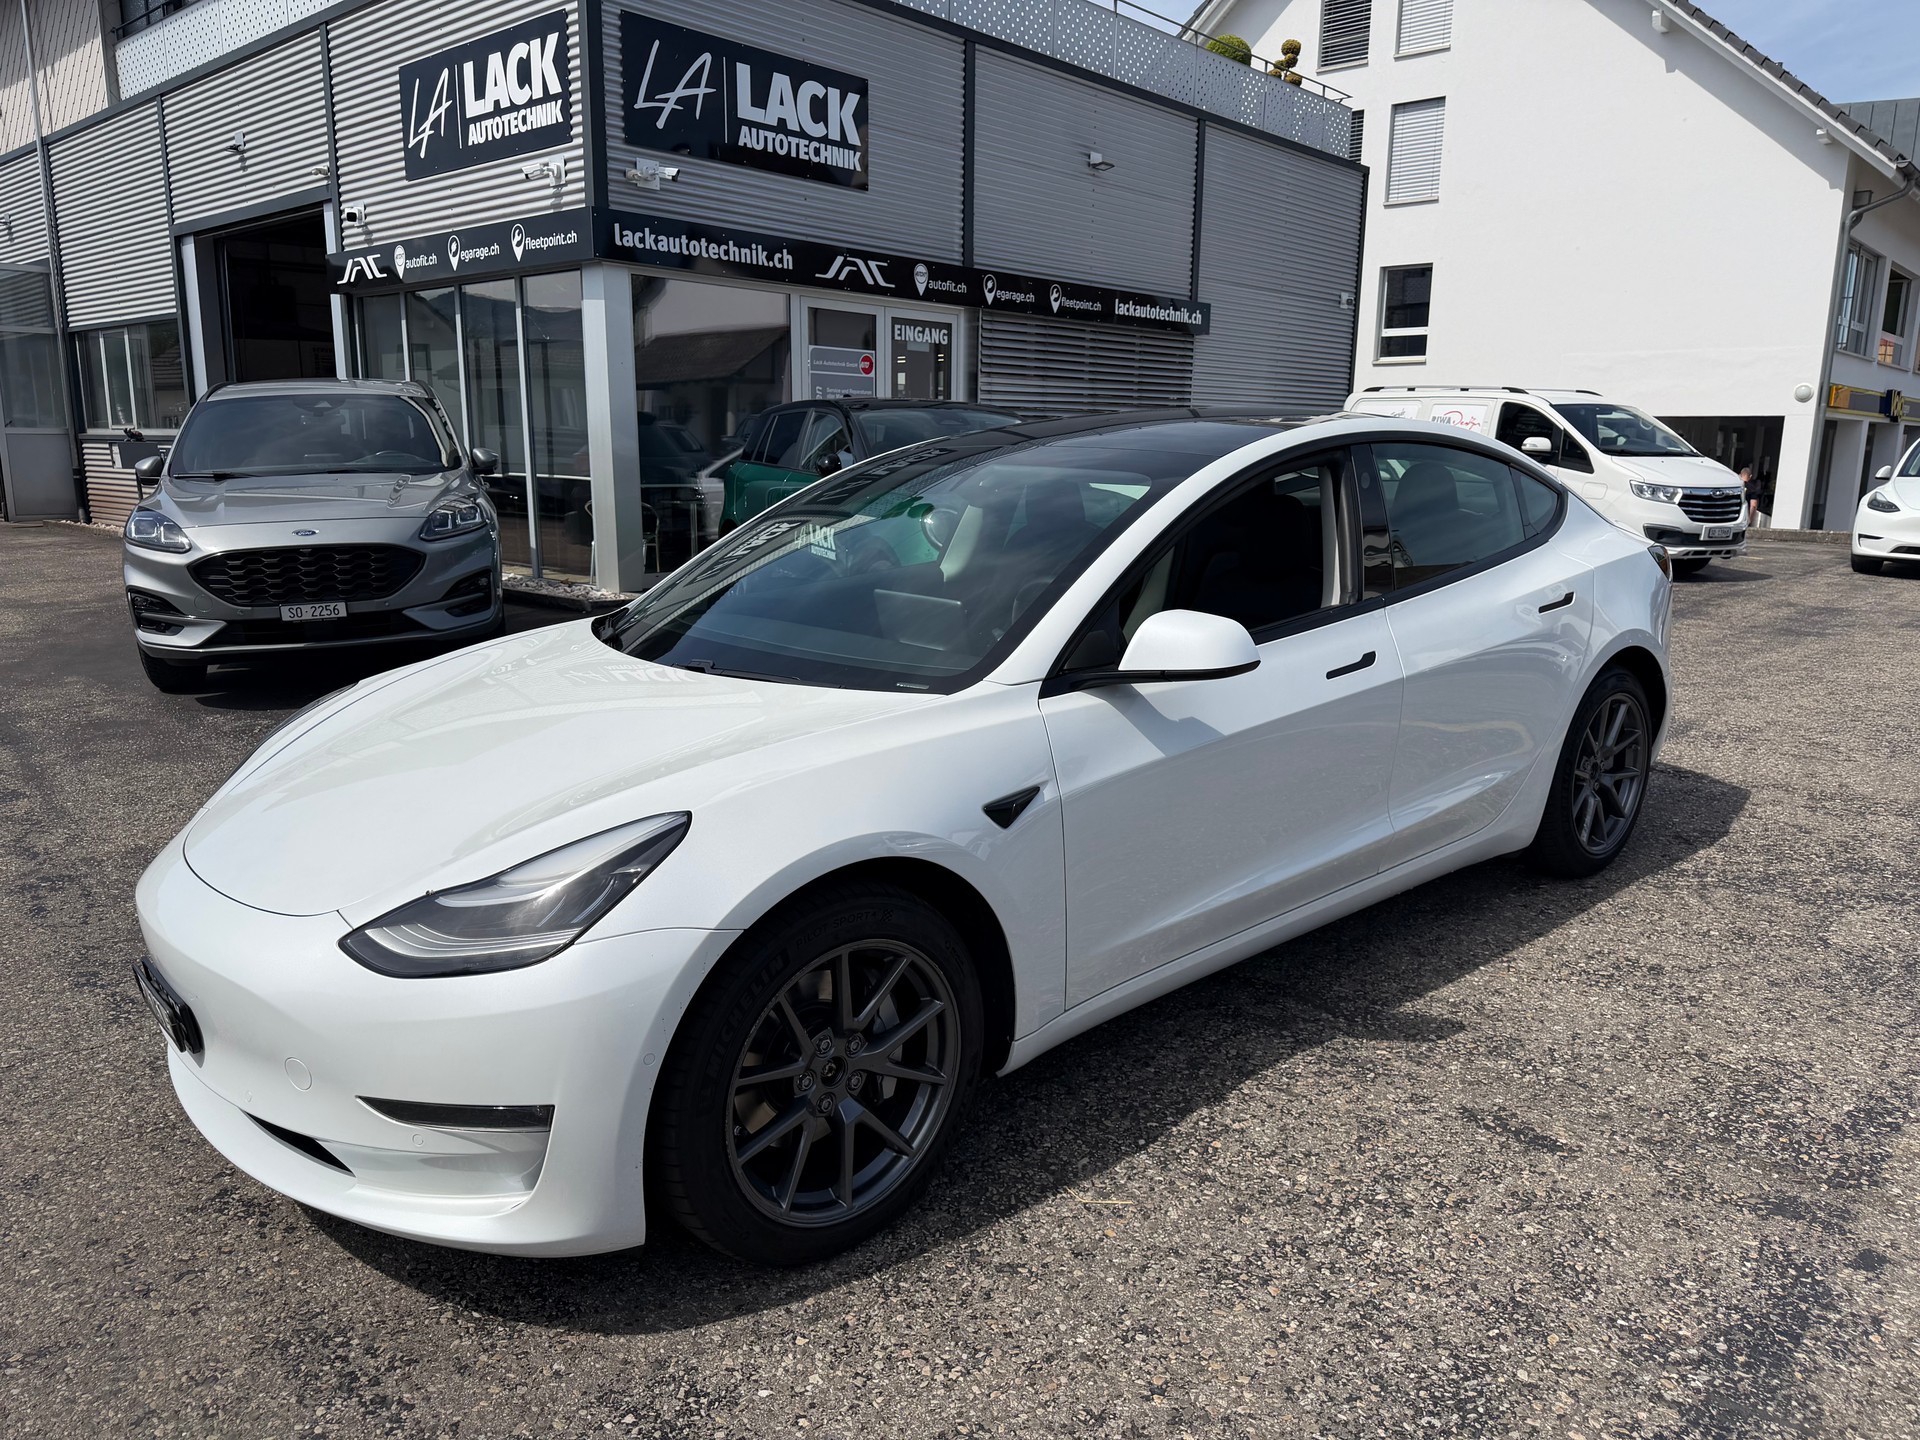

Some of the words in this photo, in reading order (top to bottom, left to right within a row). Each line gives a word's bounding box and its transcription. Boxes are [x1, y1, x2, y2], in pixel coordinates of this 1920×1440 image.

[463, 32, 562, 118] LACK
[736, 62, 861, 146] LACK
[468, 99, 563, 146] AUTOTECHNIK
[738, 125, 861, 172] AUTOTECHNIK
[525, 230, 578, 251] fleetpoint.ch
[613, 223, 794, 270] lackautotechnik.ch
[405, 253, 438, 270] autofit.ch
[460, 242, 500, 261] egarage.ch
[928, 279, 967, 294] autofit.ch
[996, 289, 1035, 304] egarage.ch
[1061, 296, 1102, 312] fleetpoint.ch
[1115, 298, 1202, 325] lackautotechnik.ch
[894, 324, 949, 345] EINGANG
[810, 524, 836, 551] LACK
[310, 604, 340, 617] 2256
[832, 911, 869, 929] SPORT
[705, 950, 786, 1077] MICHELIN
